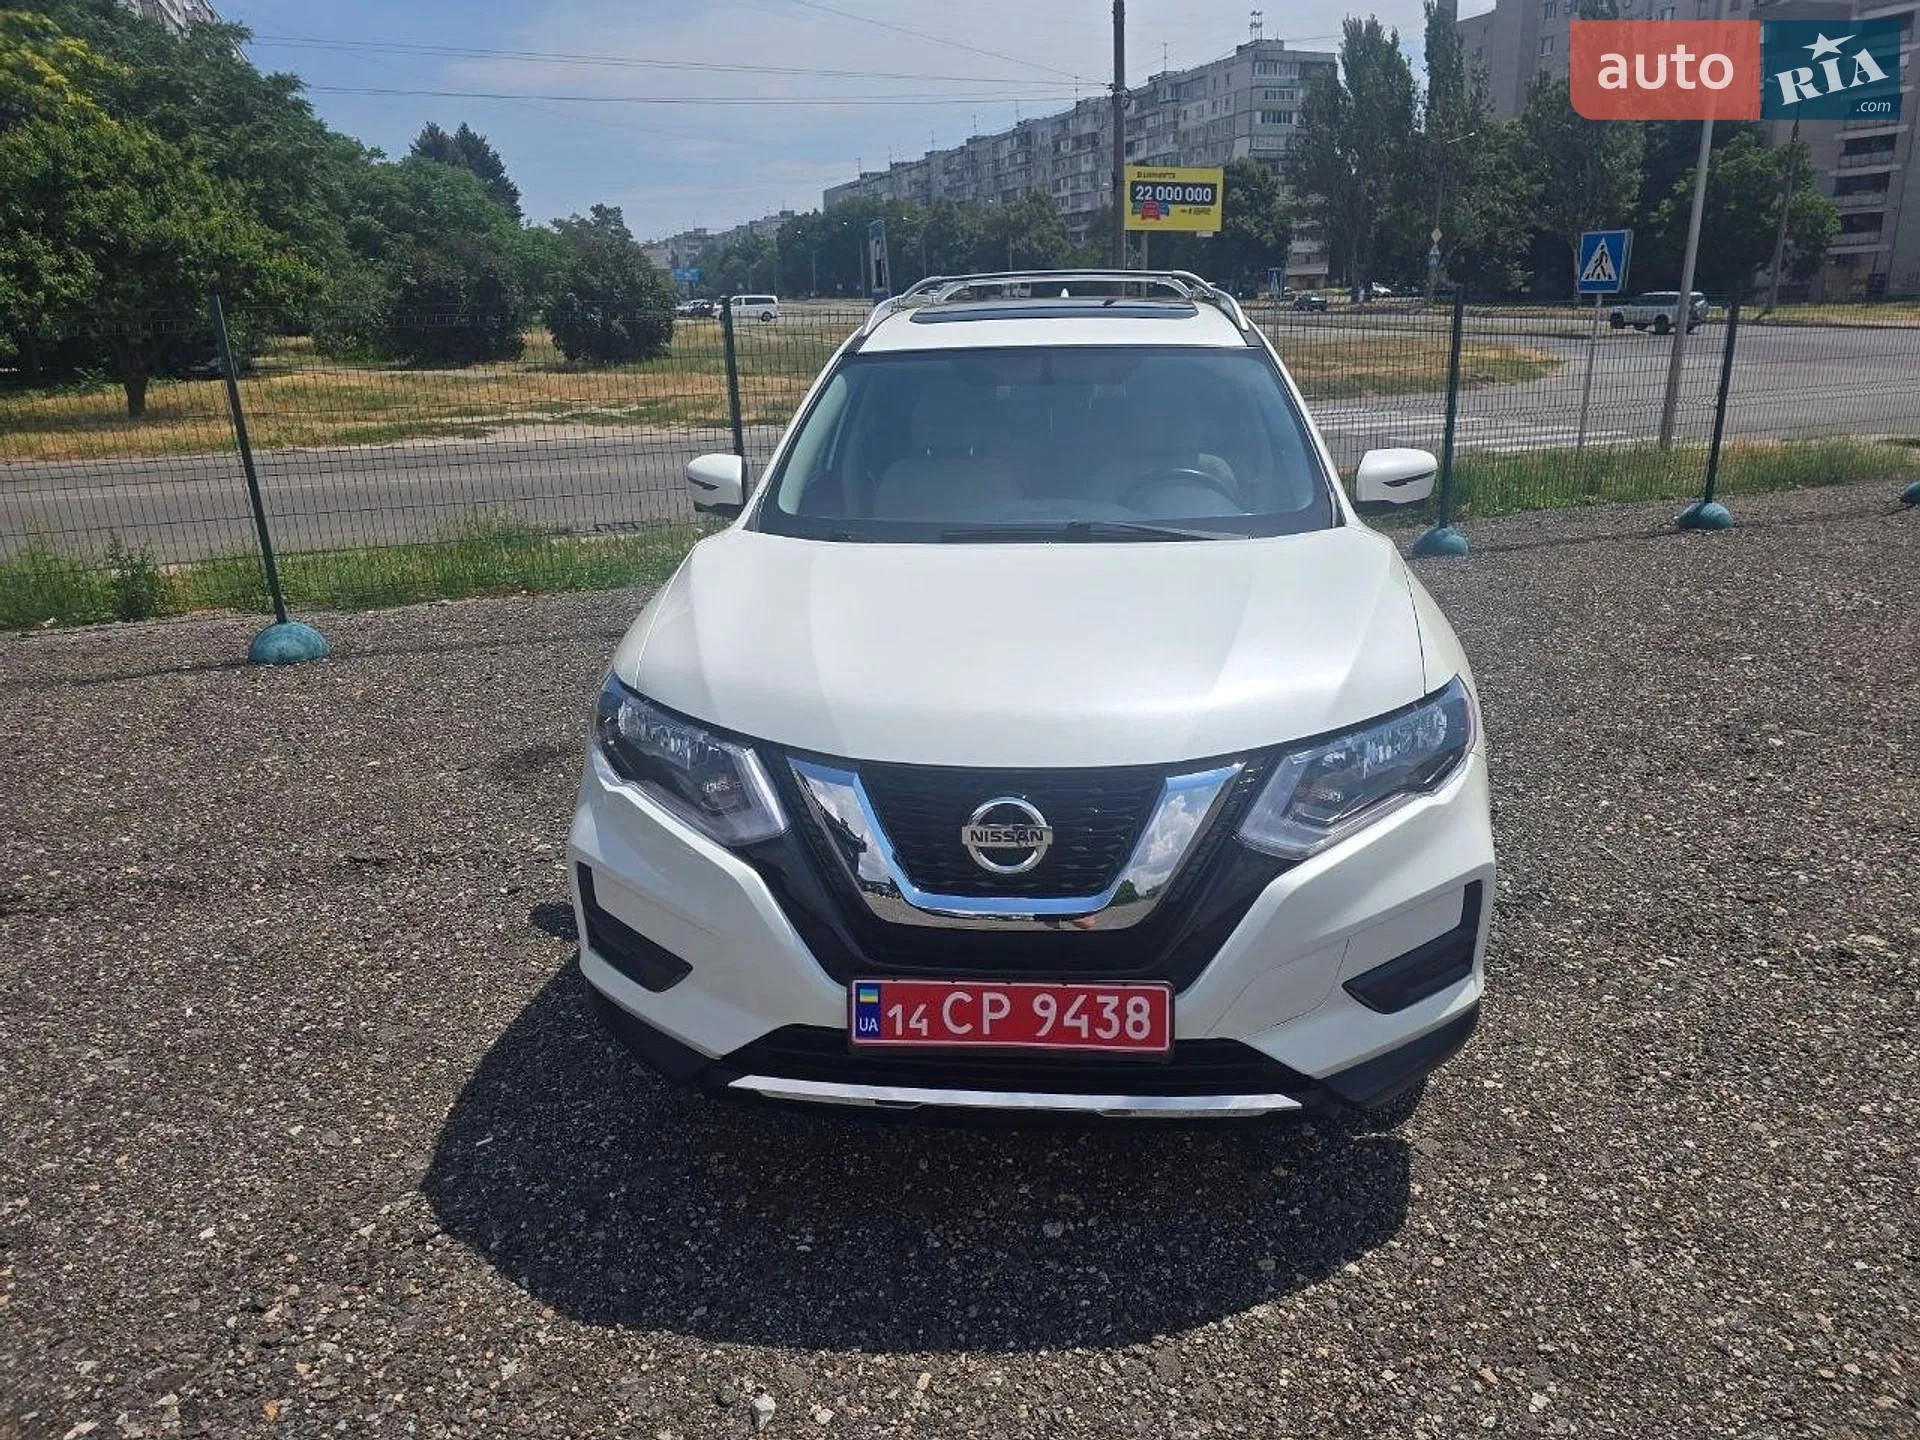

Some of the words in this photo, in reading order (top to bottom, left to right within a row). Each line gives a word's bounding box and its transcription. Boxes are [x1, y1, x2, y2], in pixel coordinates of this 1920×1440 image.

[1135, 185, 1153, 201] 22
[1156, 186, 1182, 201] 000
[1185, 187, 1212, 202] 000
[970, 829, 1044, 843] NISSAN
[887, 1003, 929, 1037] 14
[942, 991, 1011, 1035] CP
[1031, 992, 1151, 1041] 9438
[859, 1017, 879, 1033] UA
